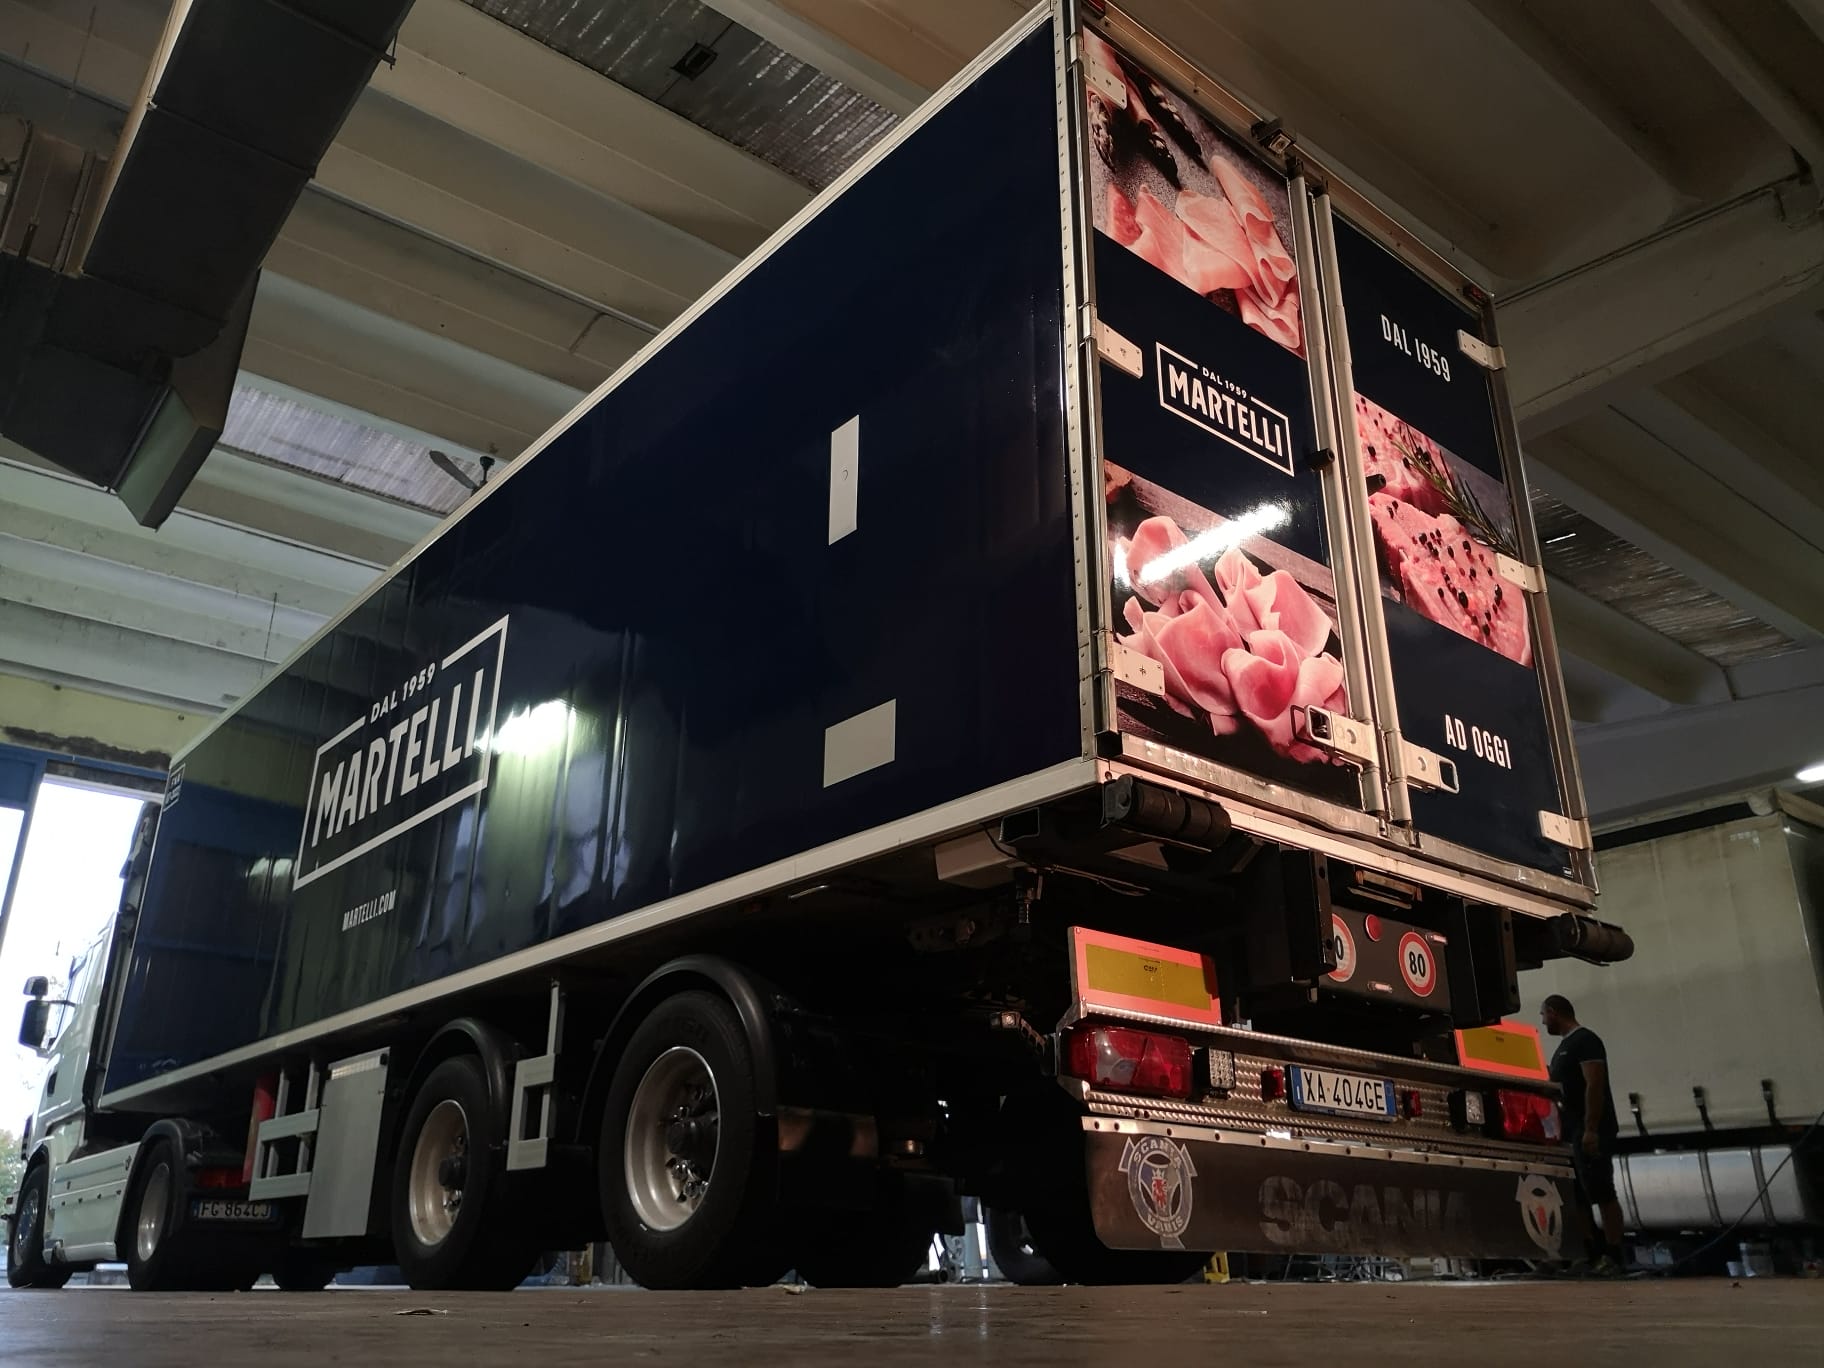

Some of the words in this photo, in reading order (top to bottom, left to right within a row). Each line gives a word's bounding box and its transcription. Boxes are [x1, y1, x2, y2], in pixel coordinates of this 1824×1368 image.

[1381, 314, 1412, 358] DAL
[1415, 337, 1451, 383] 1959
[1202, 366, 1223, 386] DAL
[1225, 379, 1248, 399] 1959
[1168, 363, 1283, 457] MARTELLI
[370, 690, 397, 724] DAL
[402, 662, 436, 701] 1959
[311, 667, 484, 848] MARTELLI
[1445, 714, 1467, 751] AD
[1471, 726, 1512, 770] OGGI
[342, 889, 396, 932] MARTELLI.COM
[1408, 951, 1426, 978] 80
[1303, 1071, 1327, 1103] XA
[1333, 1077, 1386, 1111] 404GE
[1134, 1139, 1182, 1169] SCANIA
[201, 1201, 220, 1217] FG
[1258, 1175, 1472, 1247] SCANIA
